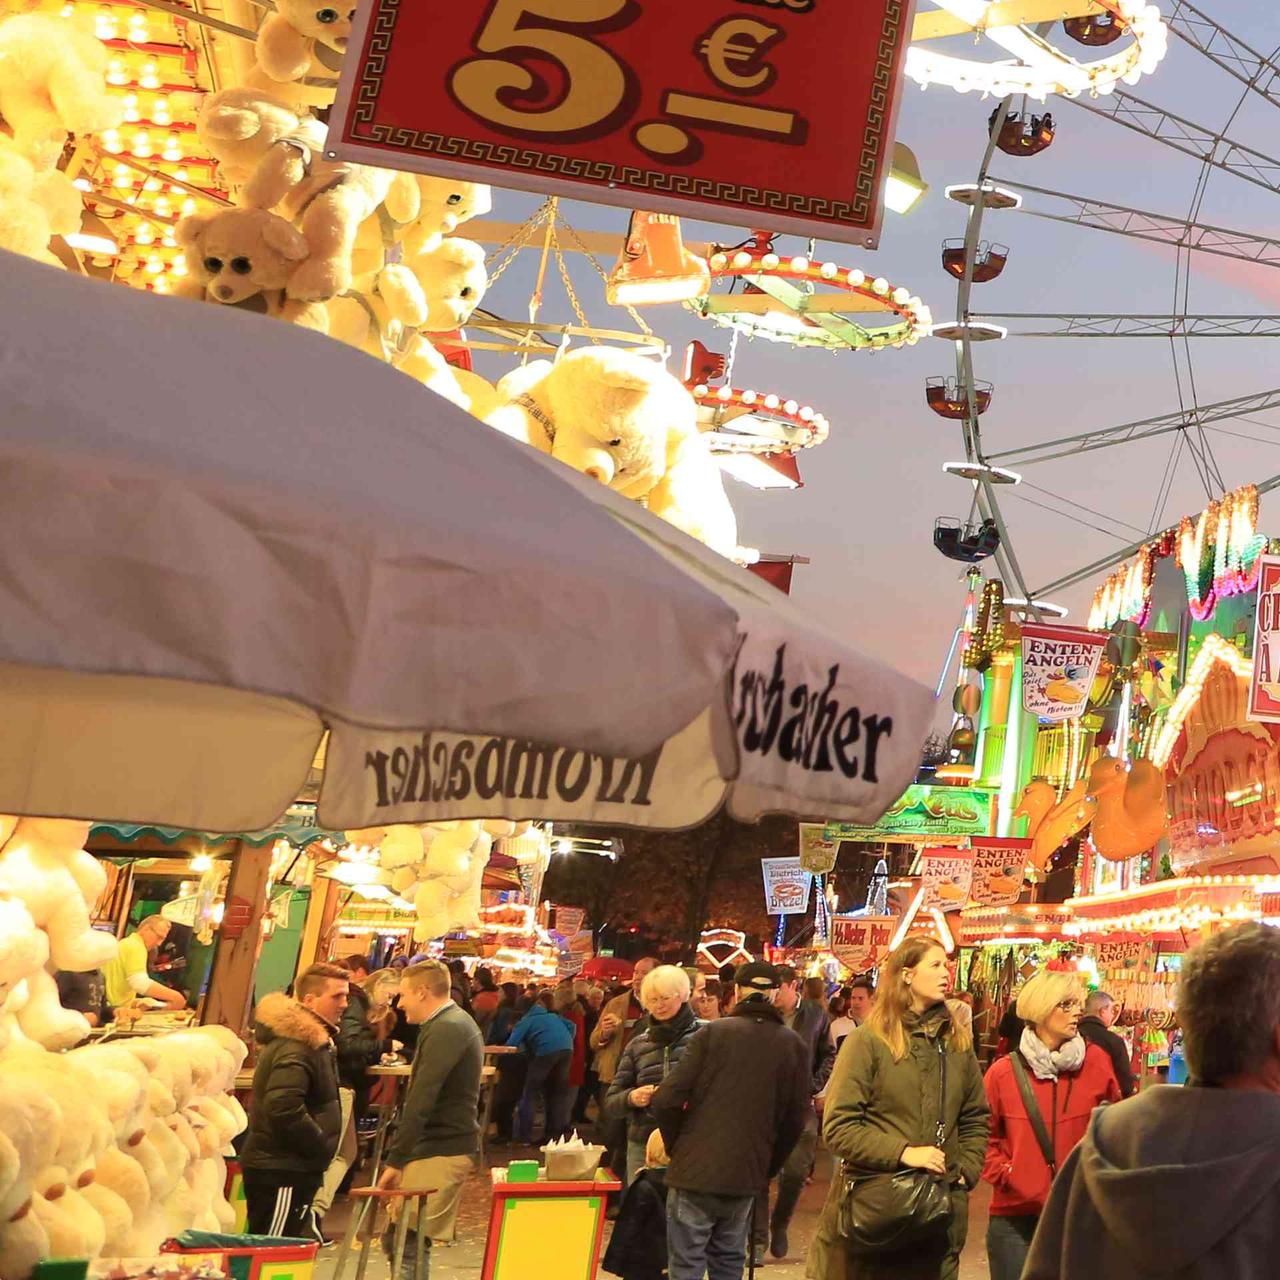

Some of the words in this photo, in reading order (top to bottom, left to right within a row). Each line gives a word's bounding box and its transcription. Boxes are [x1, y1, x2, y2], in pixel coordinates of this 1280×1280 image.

[1030, 639, 1096, 656] ENTEN-
[1025, 653, 1093, 667] ANGELN
[1259, 634, 1272, 683] À
